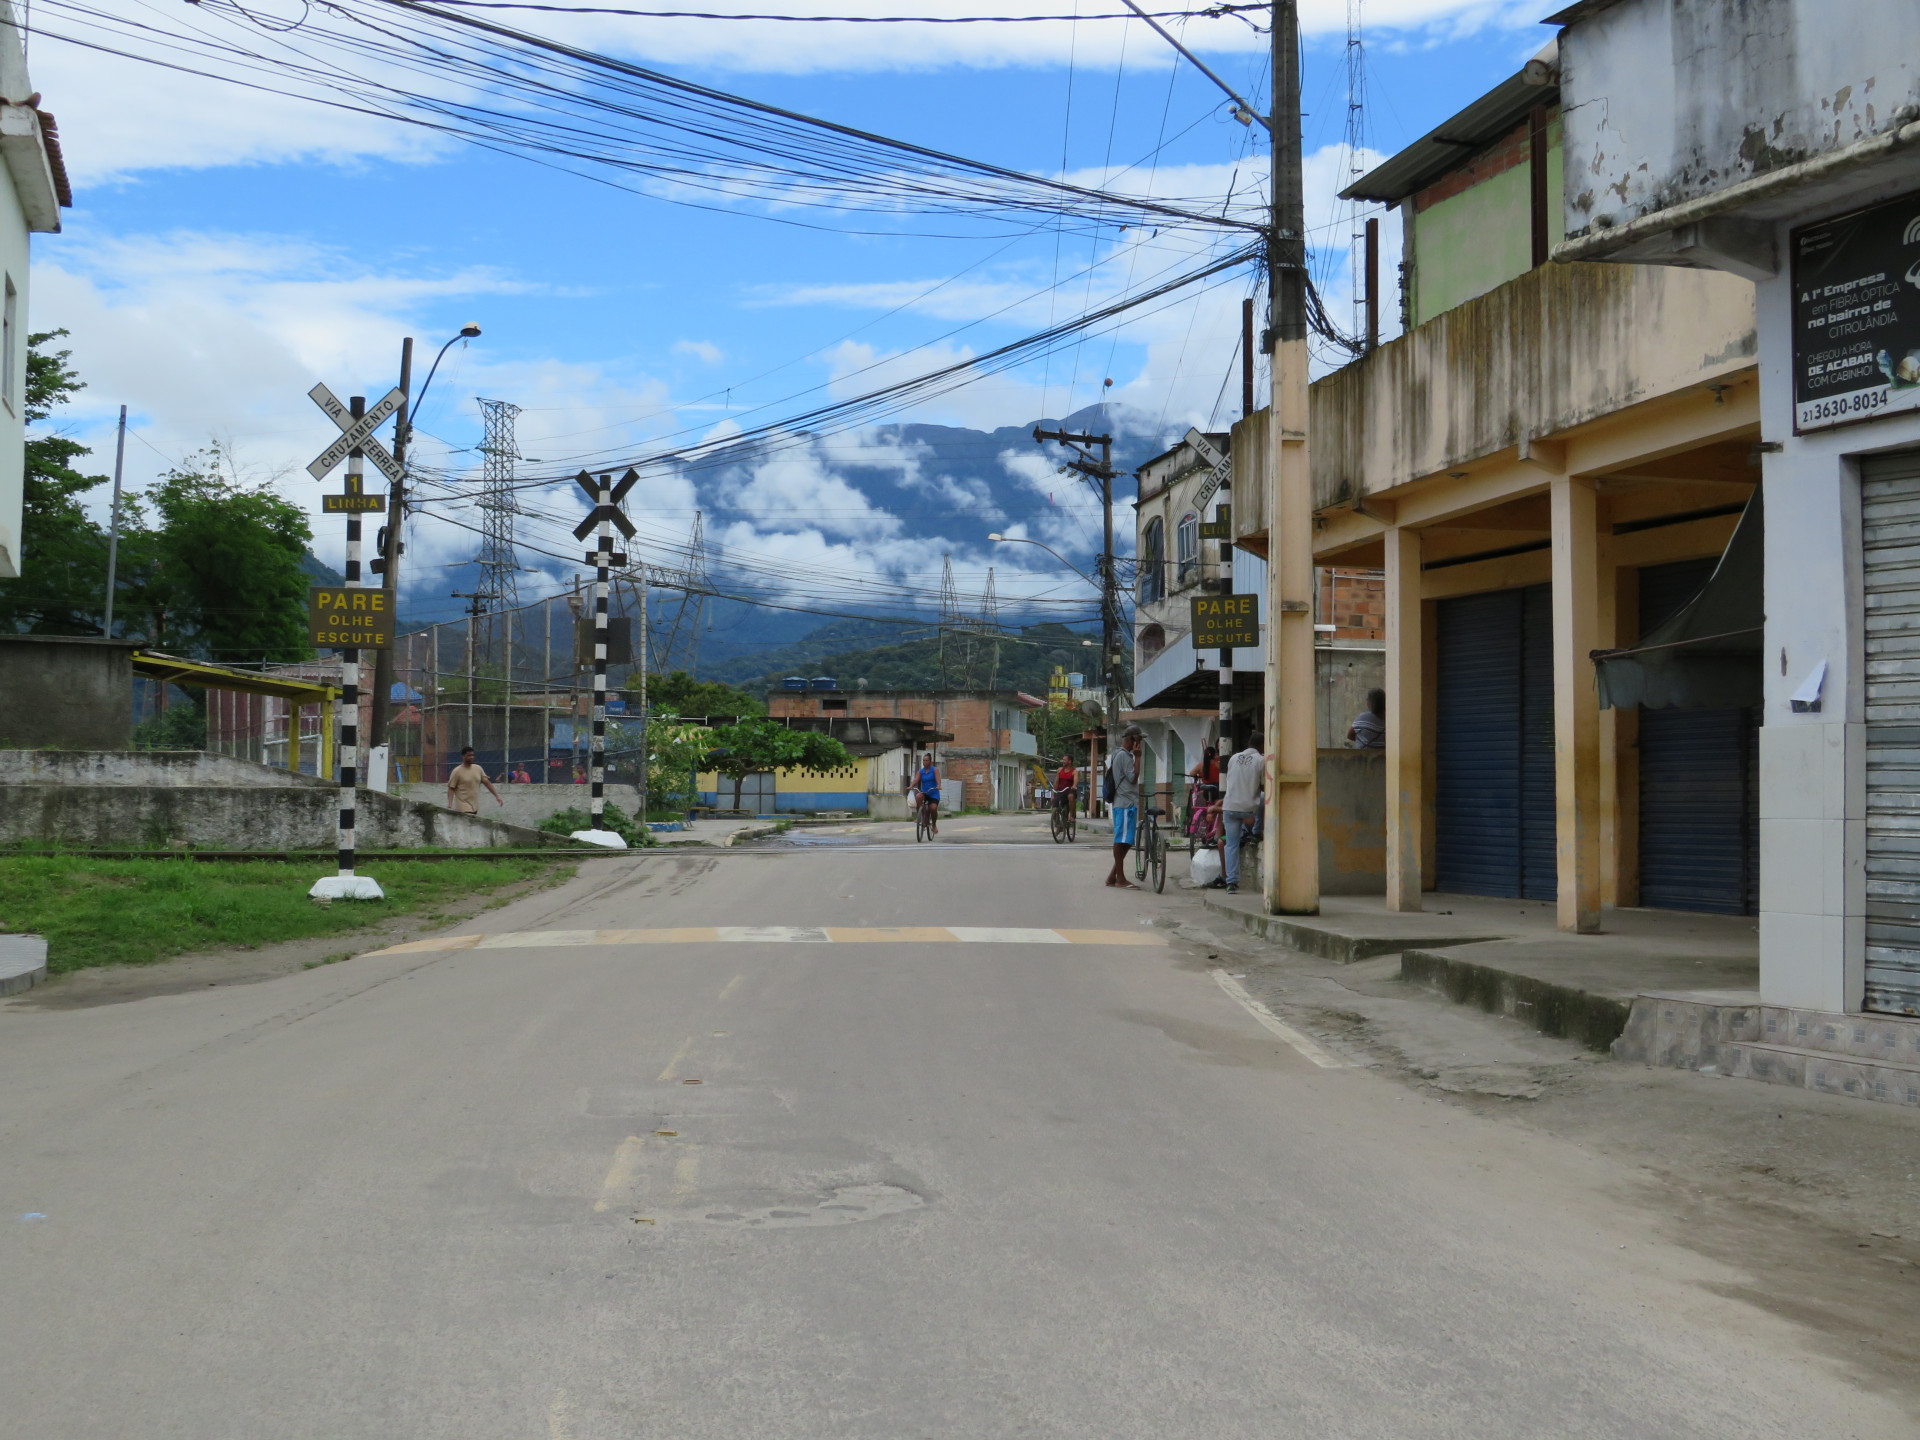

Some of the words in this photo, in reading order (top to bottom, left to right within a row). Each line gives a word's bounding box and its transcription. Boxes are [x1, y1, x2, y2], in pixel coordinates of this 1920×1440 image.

[1801, 291, 1810, 303] A
[1824, 272, 1886, 297] Empresa
[1811, 303, 1828, 316] em
[1829, 293, 1859, 312] FIBRA
[1860, 281, 1901, 303] ÓPTICA
[1807, 317, 1826, 330] no
[1827, 305, 1871, 325] bairro
[1873, 299, 1892, 313] de
[1828, 311, 1899, 339] CITROLÂNDIA
[1807, 348, 1840, 365] CHEGOU
[1841, 346, 1848, 356] A
[1850, 340, 1872, 355] HORA
[1807, 364, 1825, 377] DE
[1826, 352, 1873, 372] ACABAR
[1807, 375, 1829, 389] COM
[1830, 365, 1873, 384] CABINHO!
[324, 397, 344, 419] VIA
[321, 400, 394, 468] CRUZAMENTO
[1196, 439, 1212, 457] VIA
[363, 437, 401, 480] FÉRREA
[350, 476, 358, 493] 1
[328, 498, 379, 509] LINHA
[1221, 506, 1228, 521] 1
[318, 592, 384, 611] PARE
[1197, 599, 1251, 616] PARE
[328, 615, 375, 627] OLHE
[1206, 619, 1243, 629] OLHE
[317, 632, 384, 644] ESCUTE
[1198, 633, 1252, 645] ESCUTE
